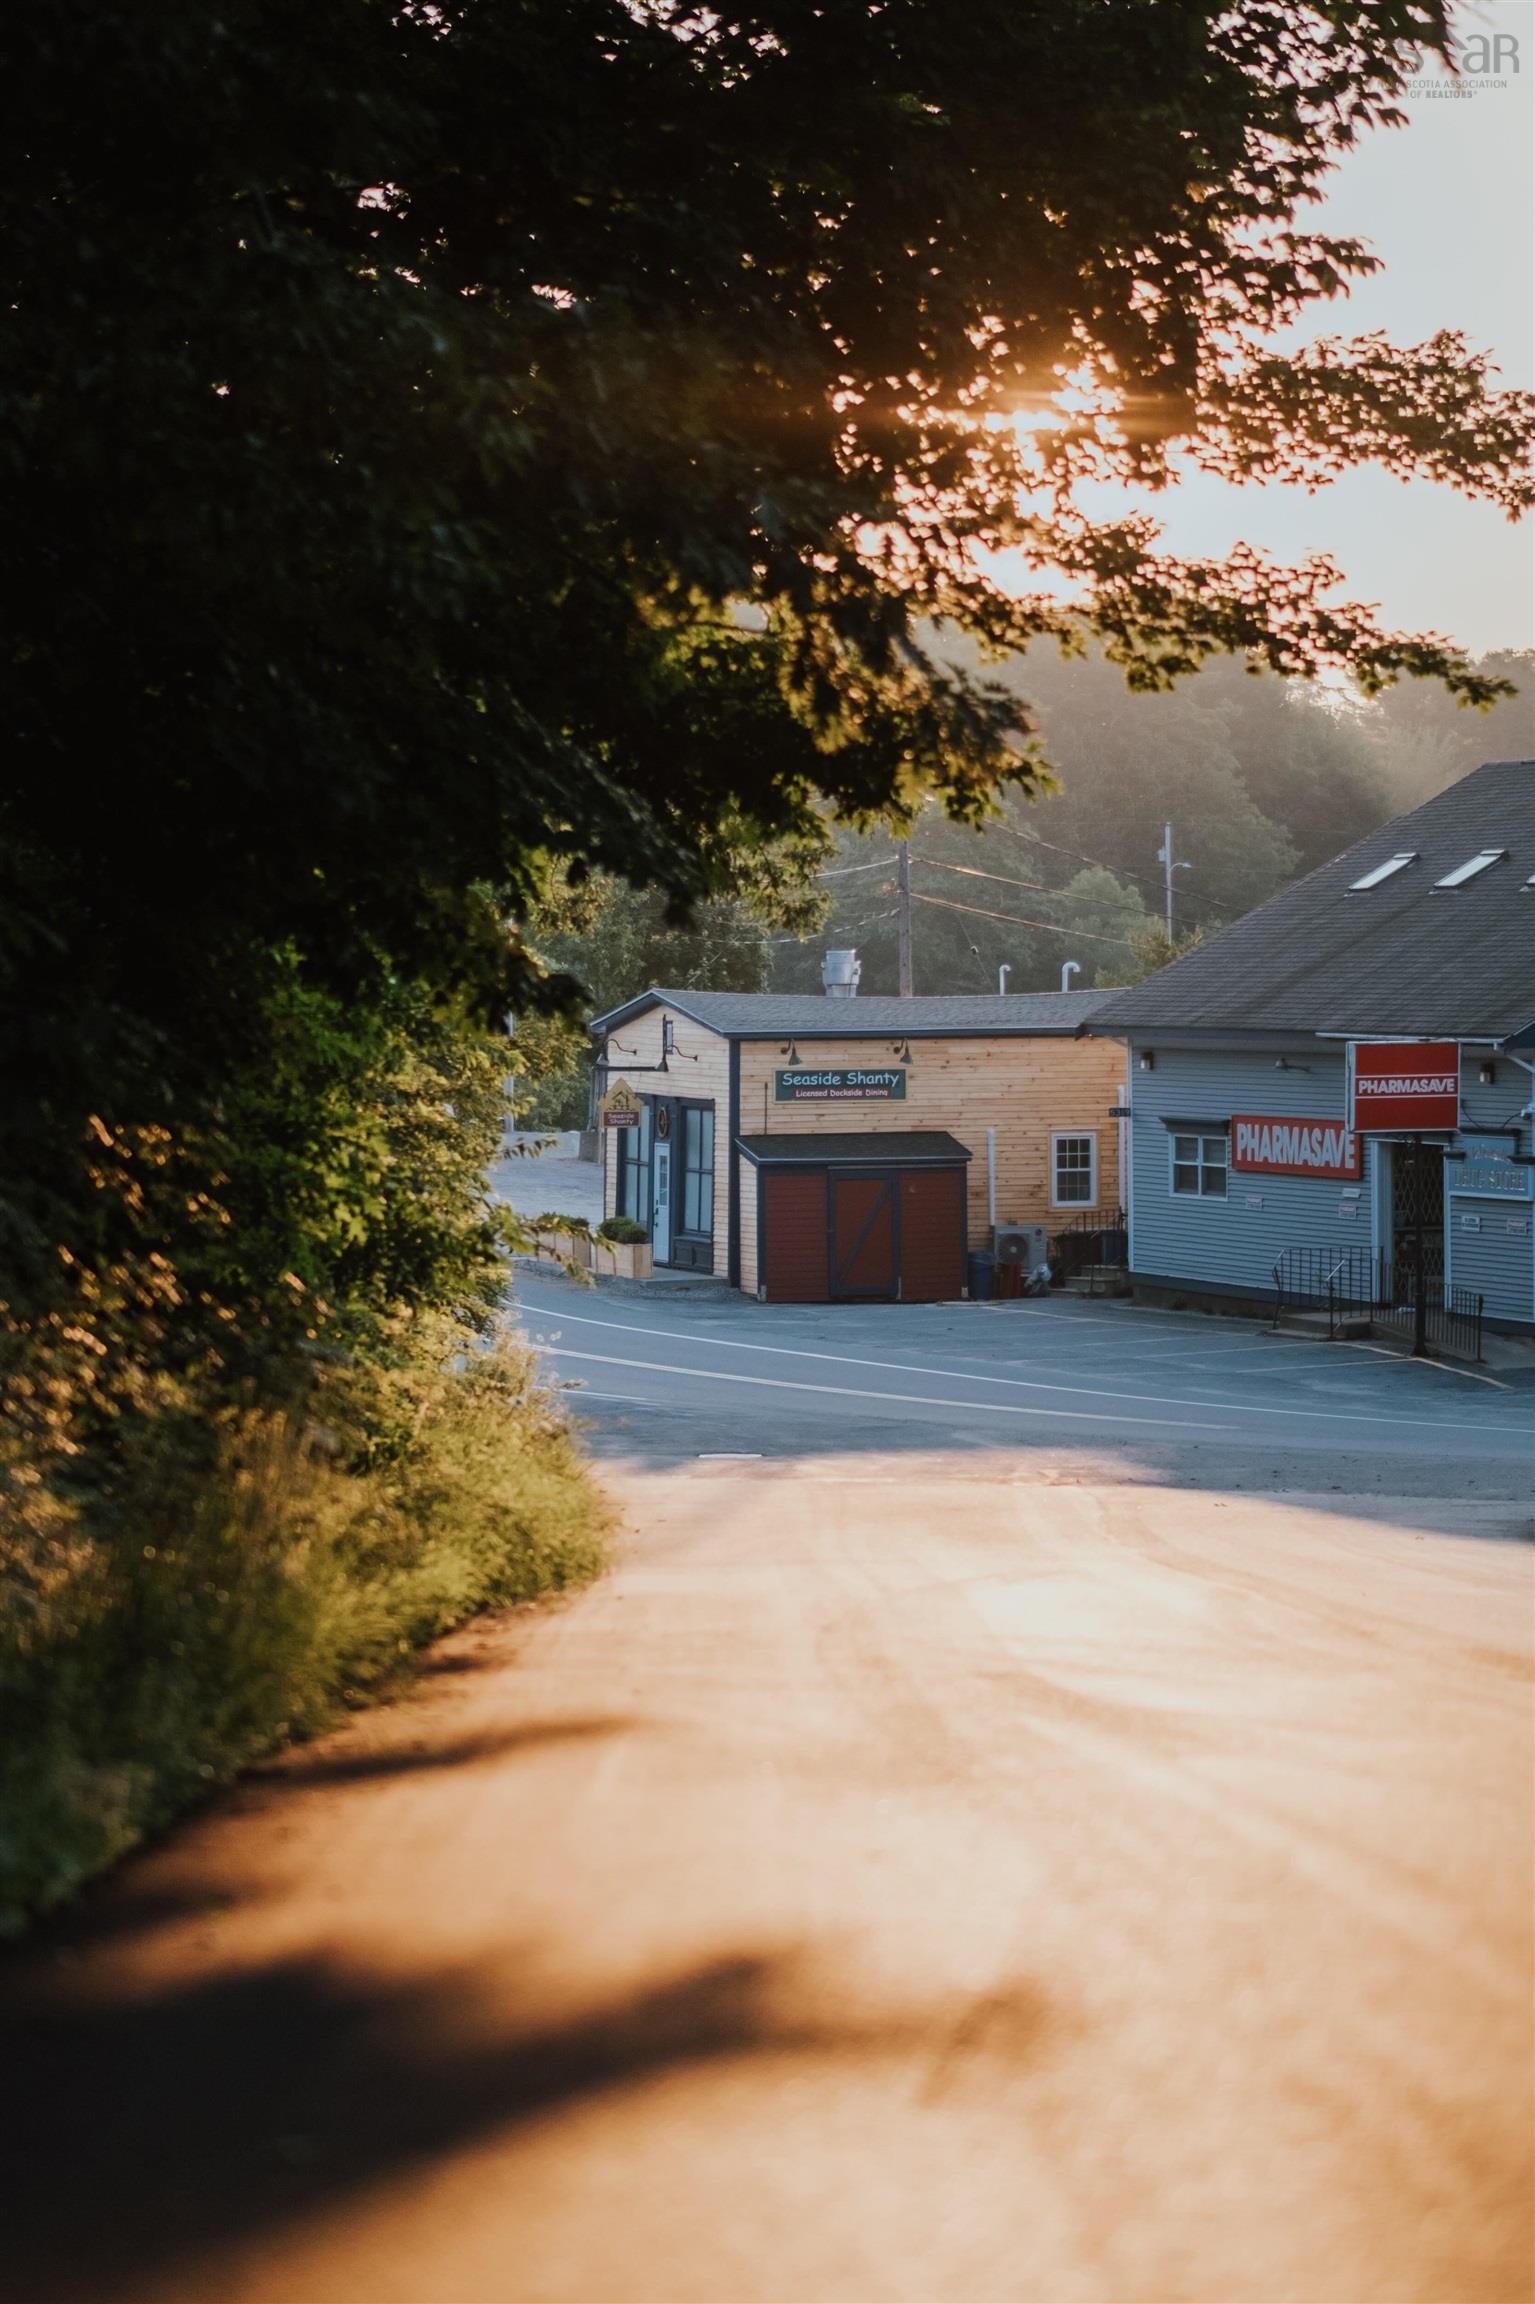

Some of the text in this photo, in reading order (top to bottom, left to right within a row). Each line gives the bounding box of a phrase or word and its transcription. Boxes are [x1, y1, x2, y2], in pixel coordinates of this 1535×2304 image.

[782, 1071, 900, 1087] Seaside Shanty
[1358, 1078, 1455, 1094] PHARMASAVE
[795, 1088, 888, 1098] Licensed Dockside Dining
[1236, 1123, 1355, 1169] PHARMASAVE
